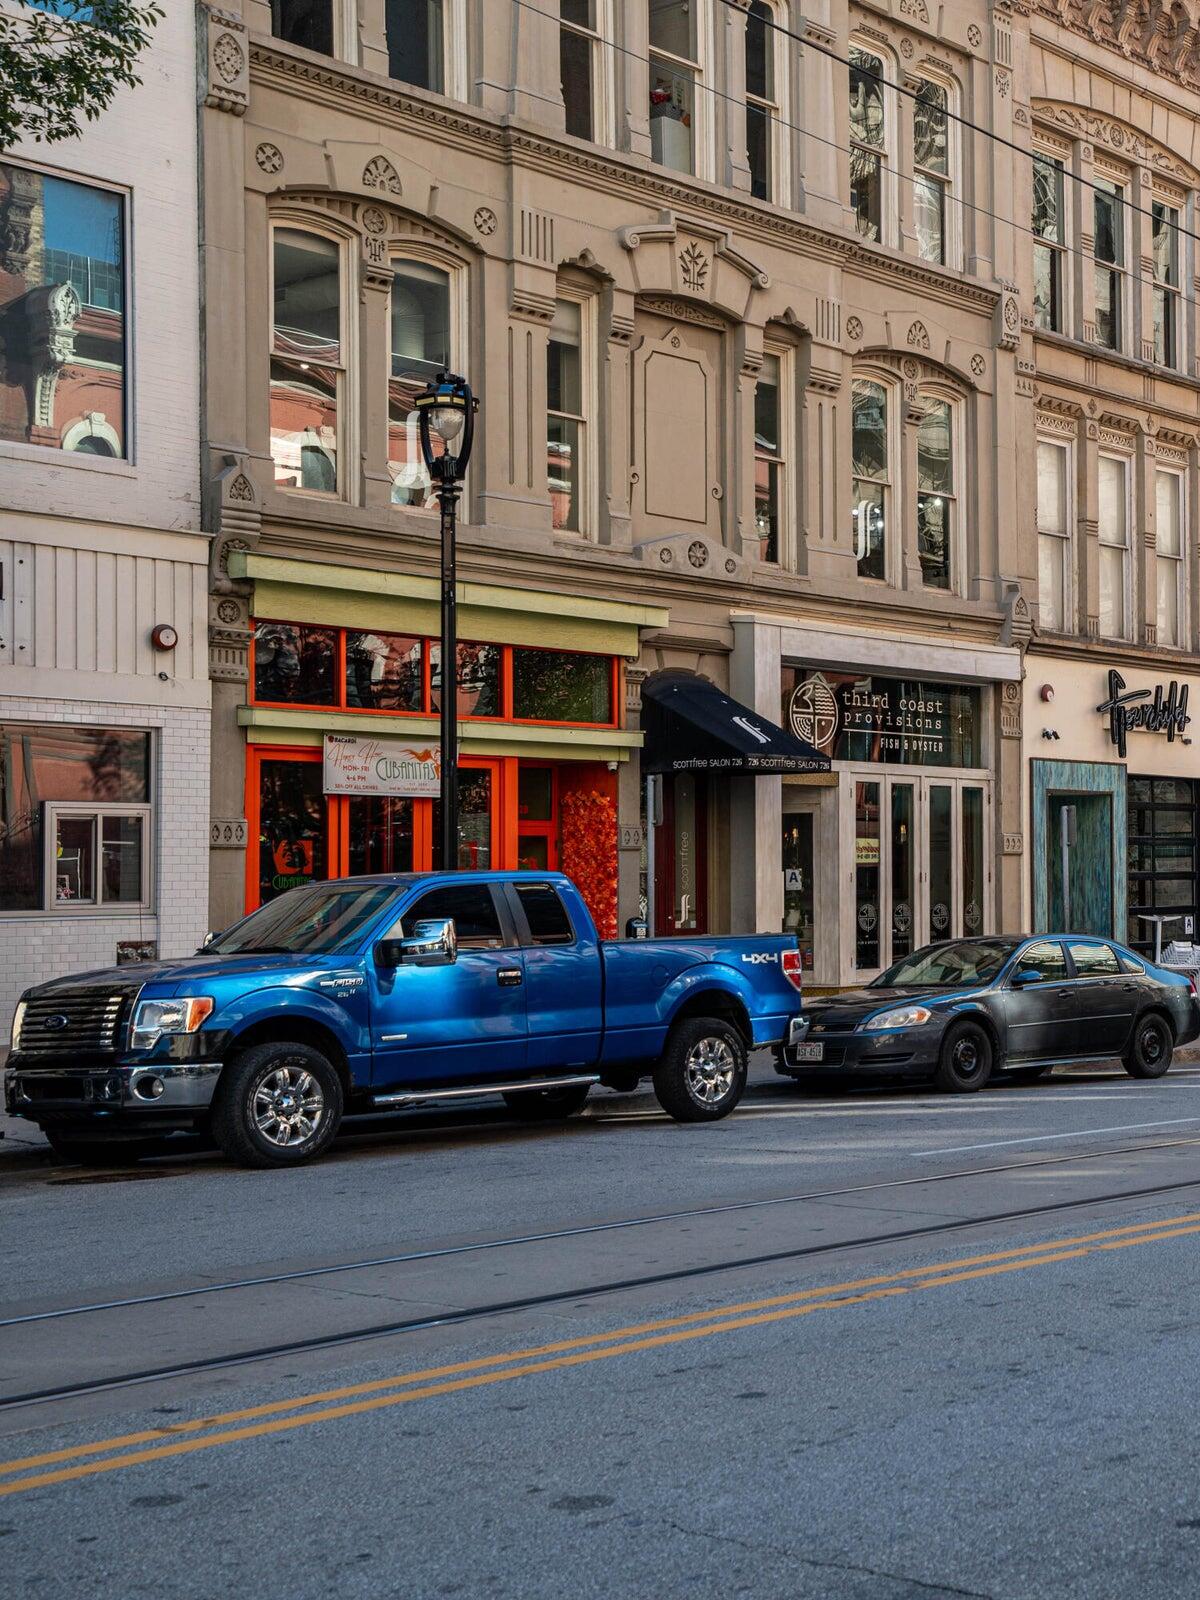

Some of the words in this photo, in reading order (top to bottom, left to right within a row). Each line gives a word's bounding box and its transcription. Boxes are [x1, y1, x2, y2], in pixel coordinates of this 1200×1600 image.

[842, 690, 889, 709] third
[900, 699, 943, 714] coast
[844, 712, 942, 730] provisions
[880, 737, 900, 749] FISH
[912, 739, 943, 752] OYSTER
[376, 757, 436, 781] CUBANITAS
[710, 758, 730, 767] SALON
[798, 760, 819, 769] SALON
[789, 872, 798, 882] A
